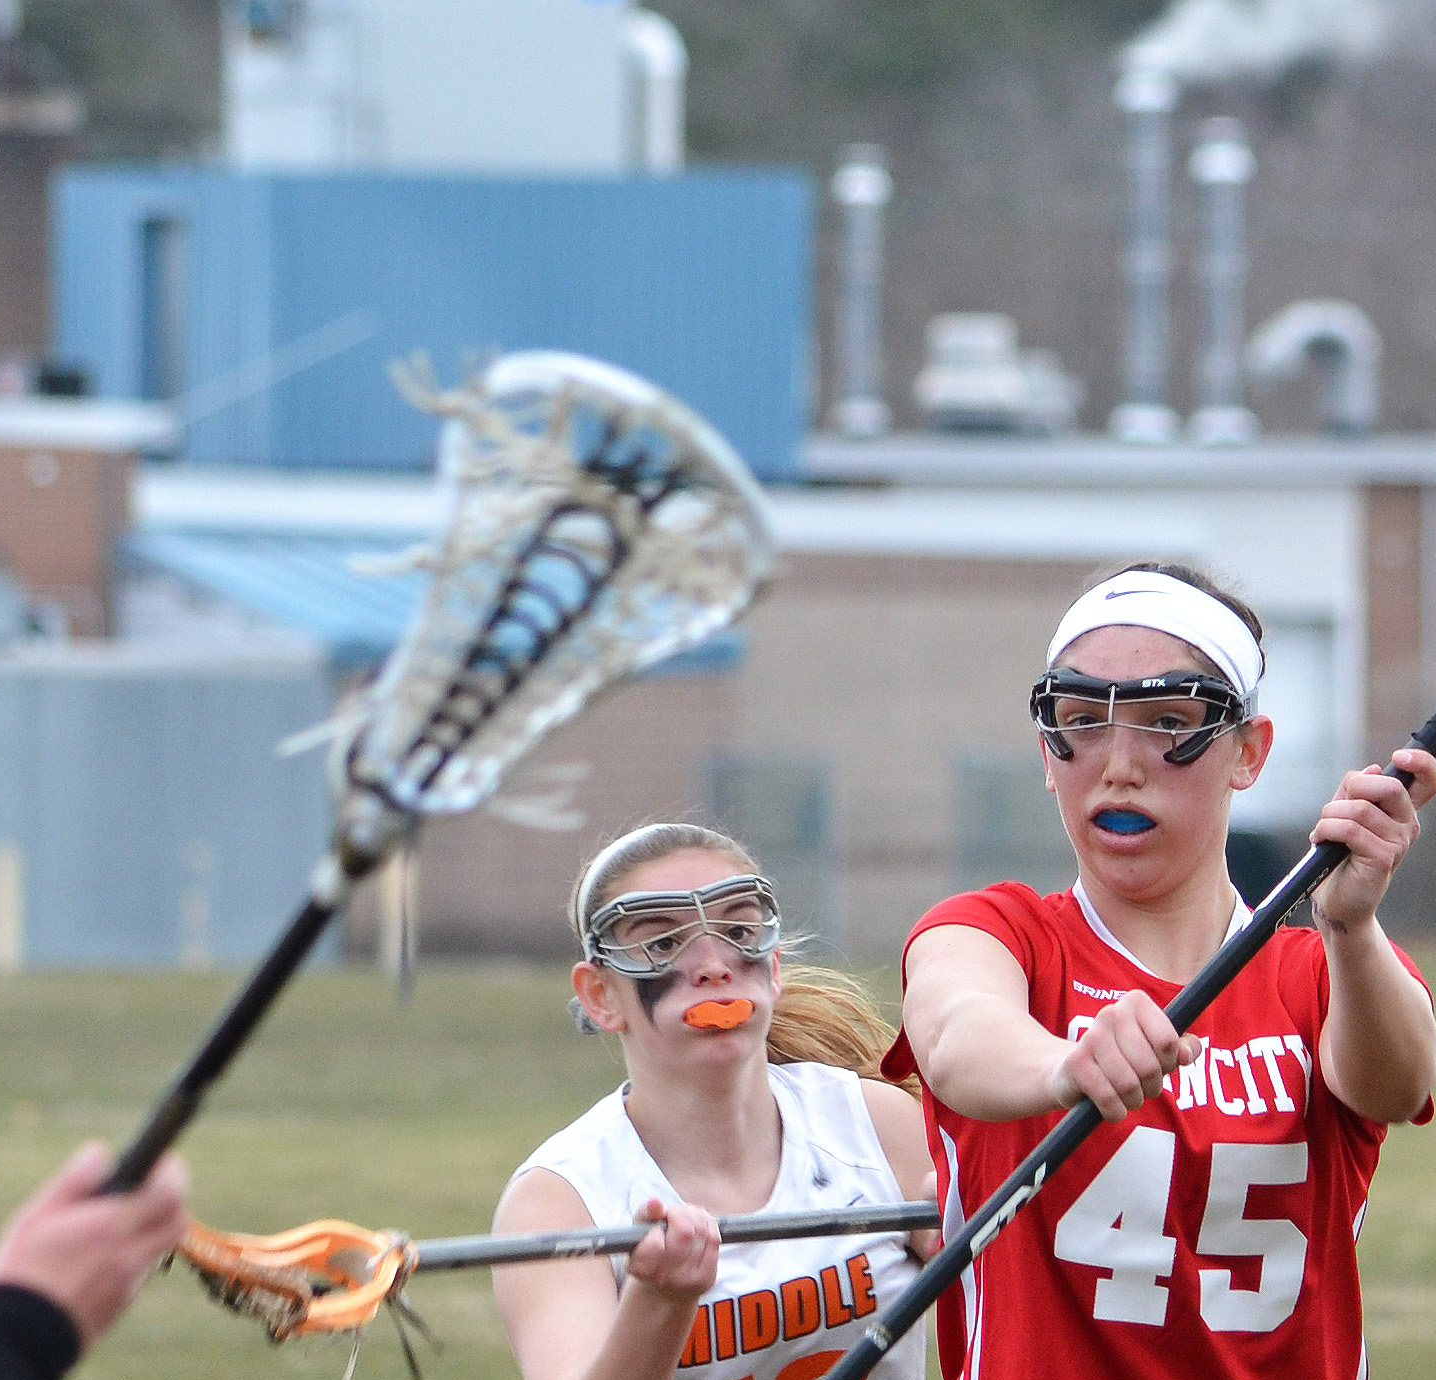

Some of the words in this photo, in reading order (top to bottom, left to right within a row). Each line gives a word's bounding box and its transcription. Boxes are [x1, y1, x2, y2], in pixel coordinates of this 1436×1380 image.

[1141, 678, 1166, 689] STX
[1073, 980, 1128, 1001] BRINE
[1209, 1034, 1312, 1117] CITY
[1054, 1126, 1309, 1332] 45
